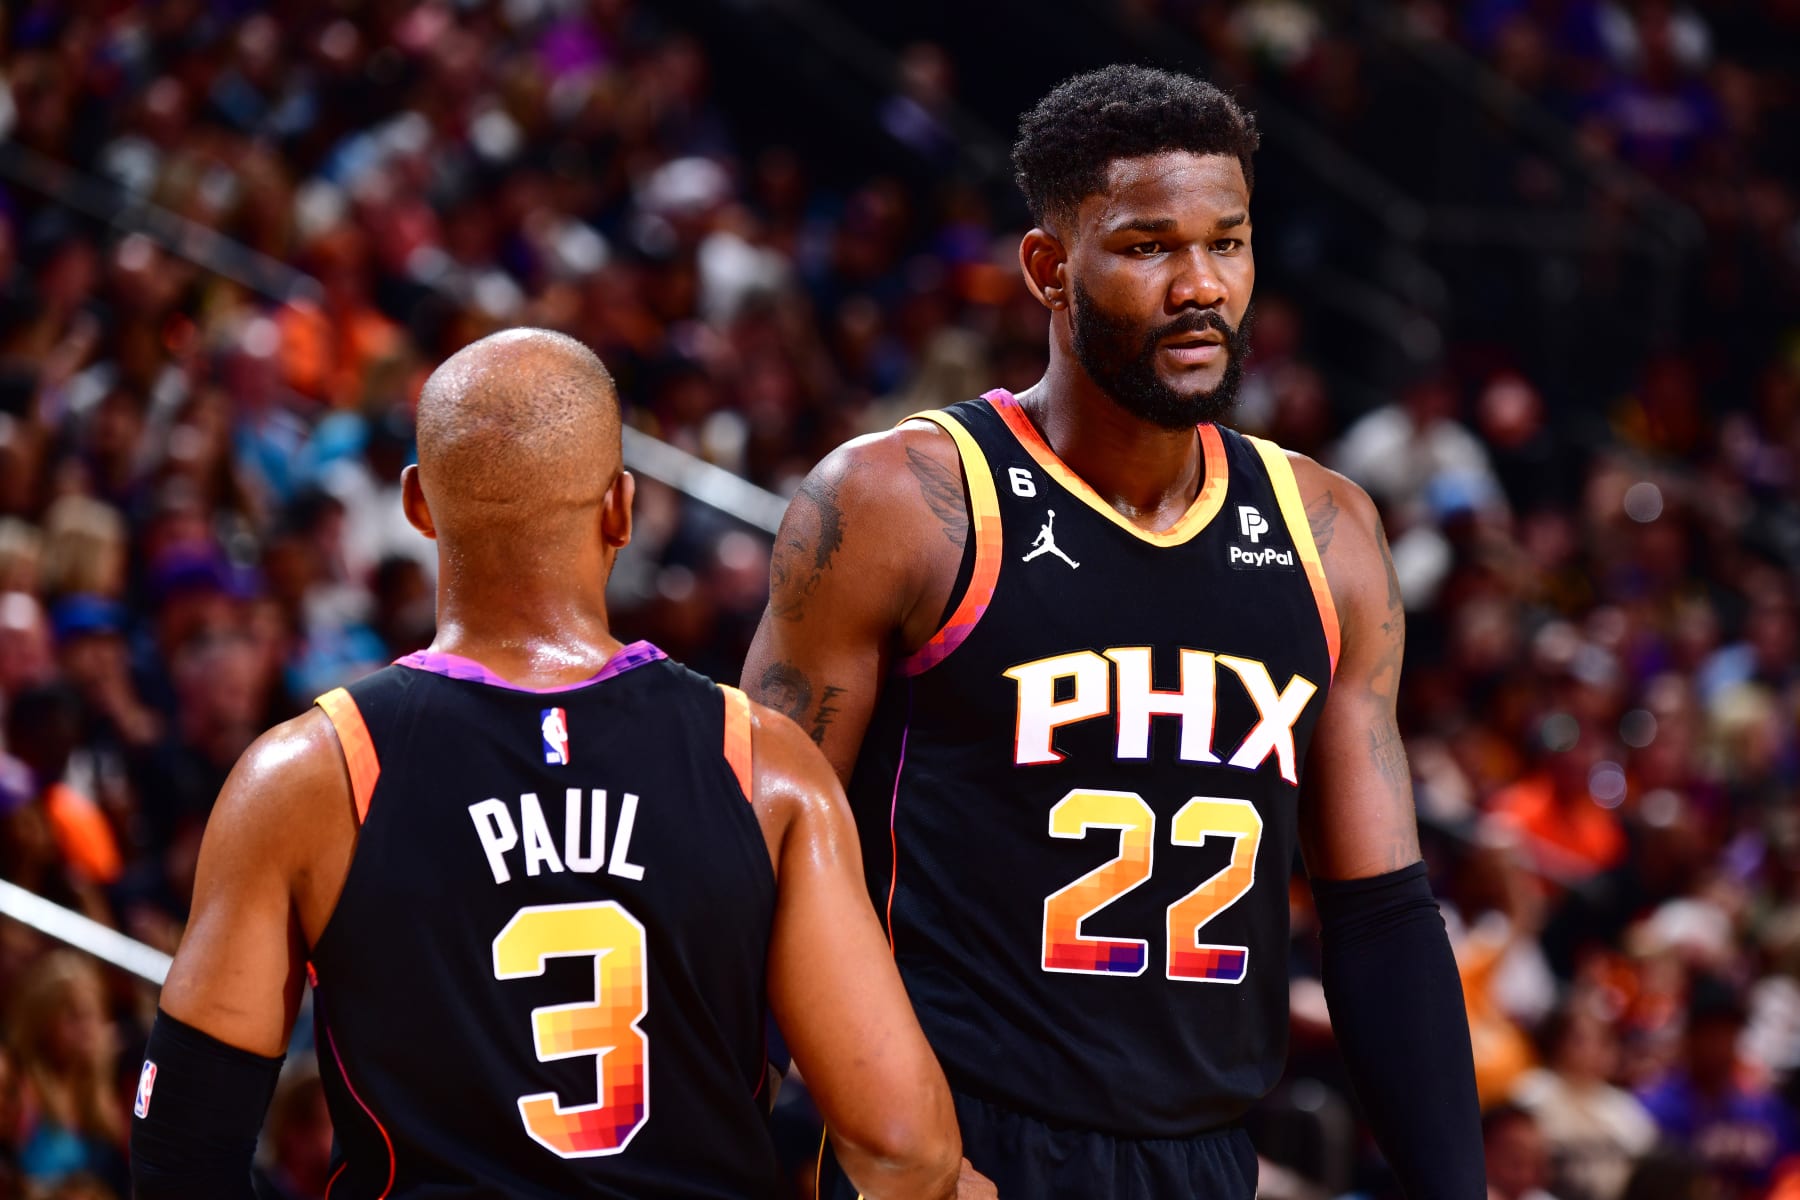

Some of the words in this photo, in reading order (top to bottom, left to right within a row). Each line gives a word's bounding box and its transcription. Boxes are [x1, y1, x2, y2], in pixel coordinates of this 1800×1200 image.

[1008, 466, 1037, 498] 6
[1230, 546, 1294, 567] PayPal
[1002, 646, 1318, 788] PHX
[468, 788, 645, 885] PAUL
[1041, 788, 1263, 985] 22
[492, 900, 649, 1160] 3
